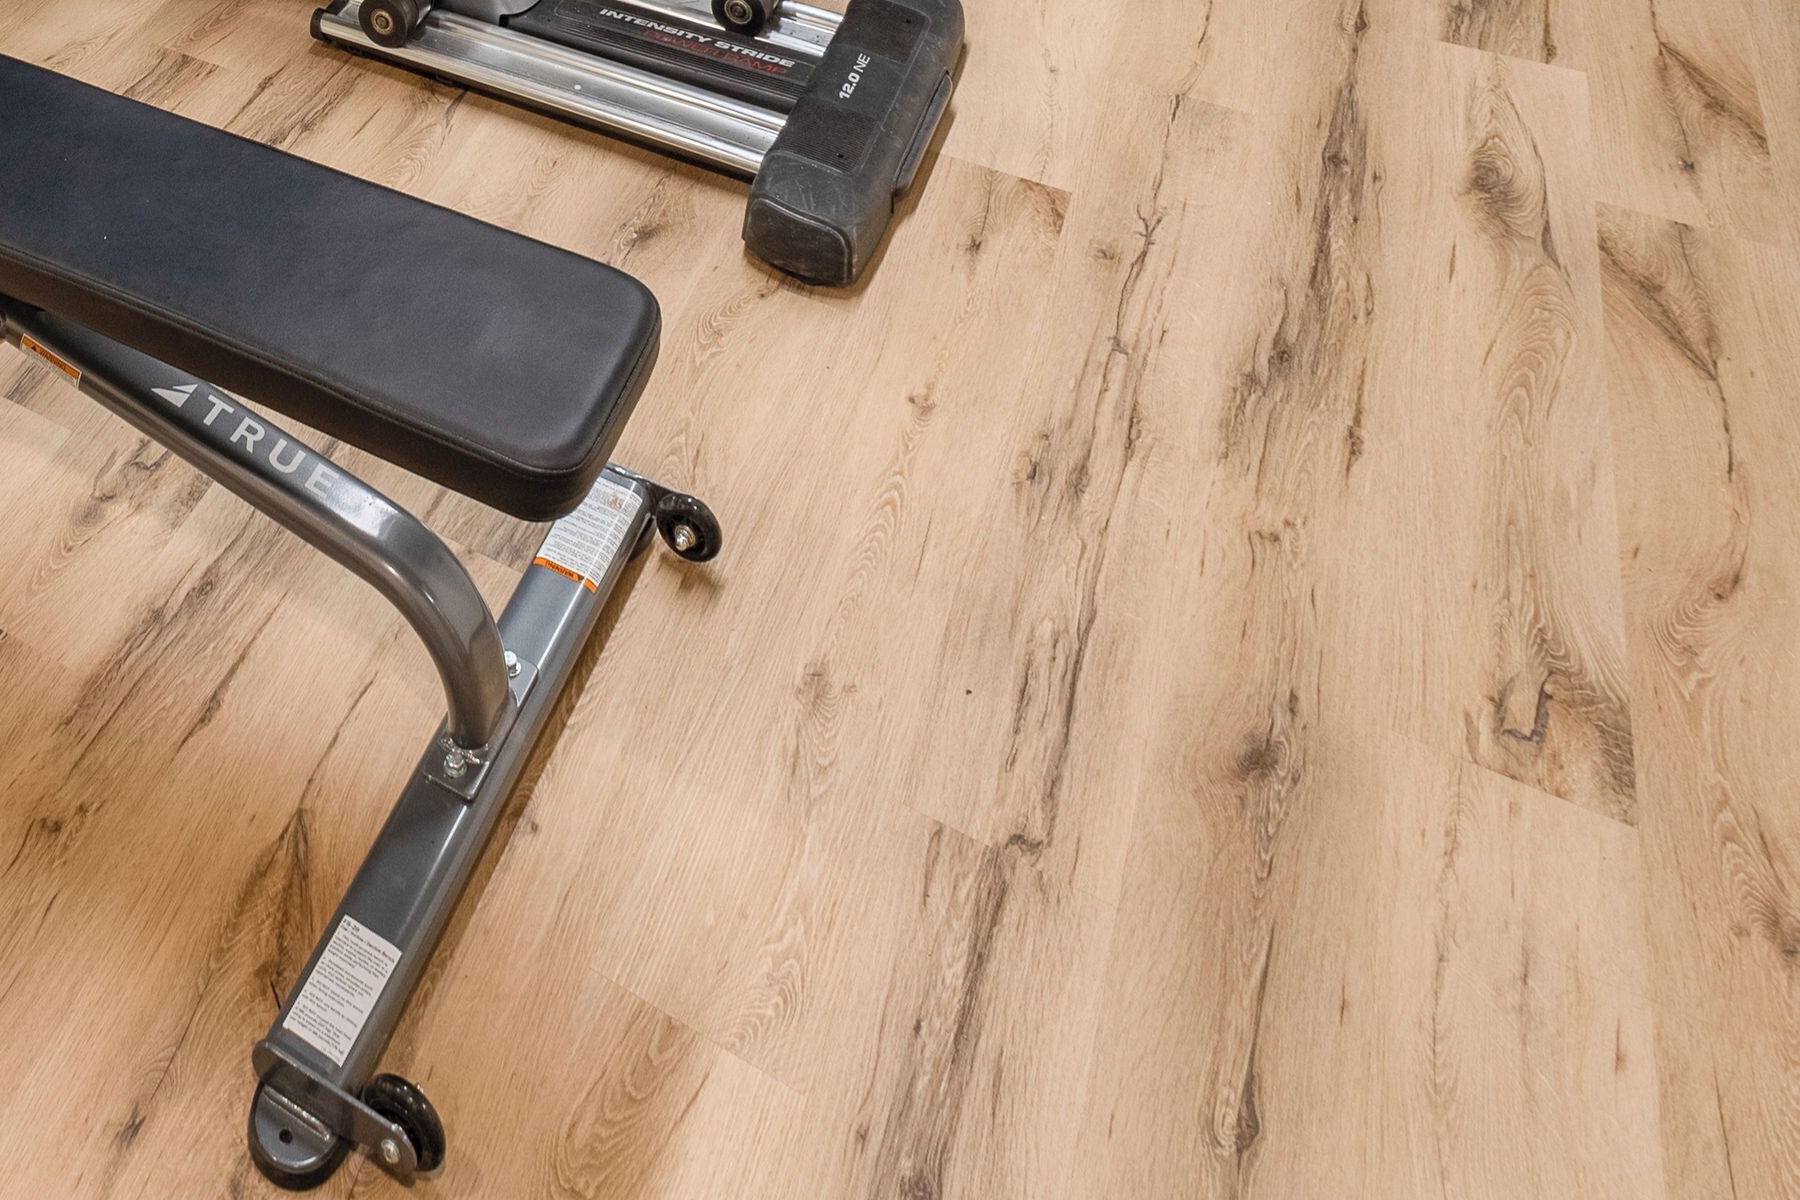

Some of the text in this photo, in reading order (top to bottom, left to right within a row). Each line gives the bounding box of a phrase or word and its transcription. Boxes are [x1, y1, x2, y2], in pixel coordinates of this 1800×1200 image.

[600, 8, 795, 68] INTENSITY STRIDE
[643, 29, 788, 75] POWER RAMP
[838, 53, 870, 99] 12.0 NE
[203, 394, 341, 498] TRUE
